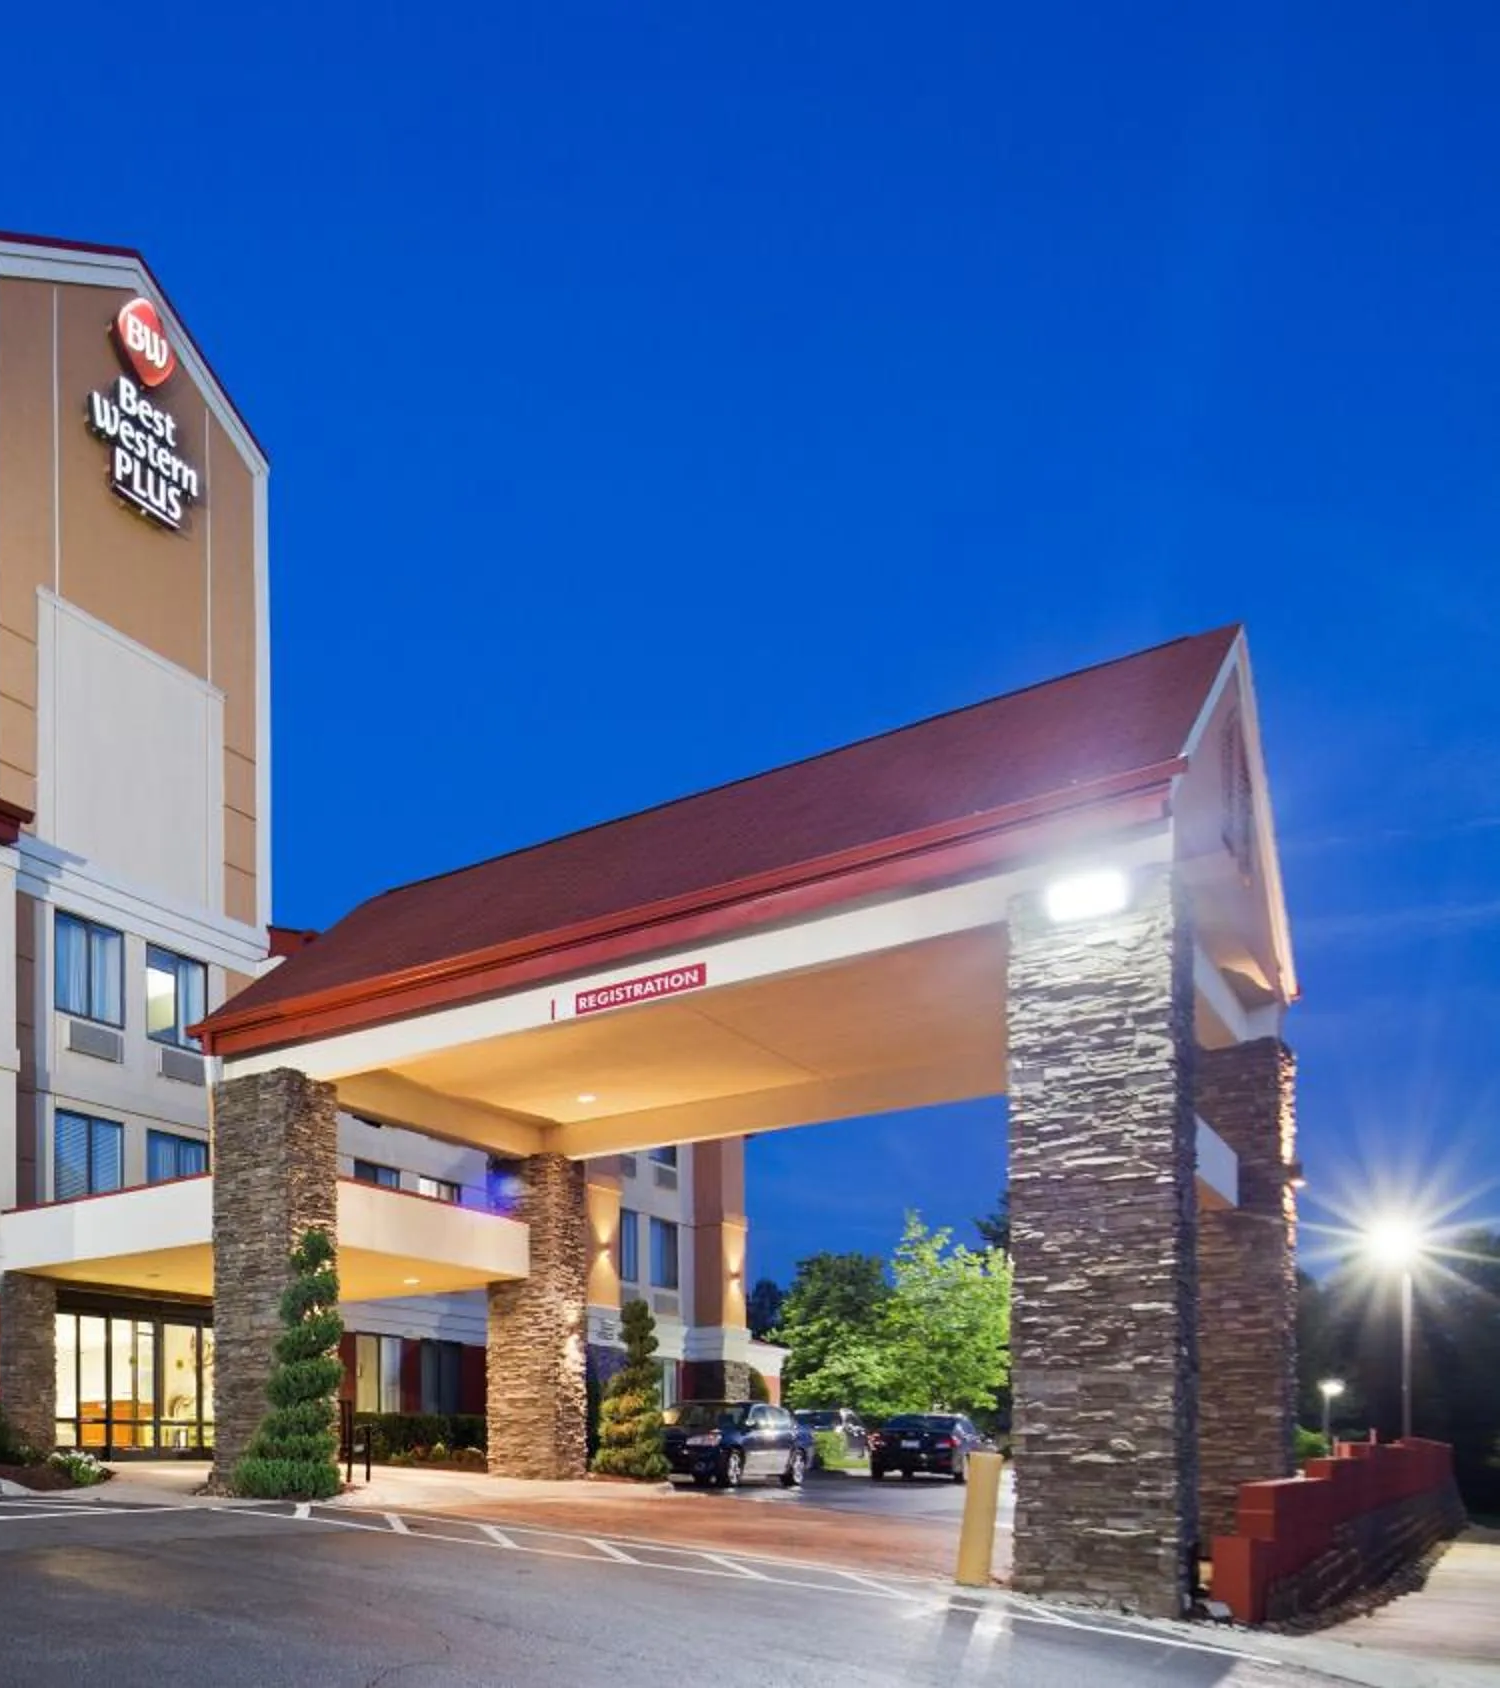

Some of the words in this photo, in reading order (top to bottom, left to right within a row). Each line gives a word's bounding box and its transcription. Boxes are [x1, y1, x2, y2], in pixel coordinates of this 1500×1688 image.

[126, 311, 168, 369] BW
[92, 391, 198, 497] Western
[119, 375, 176, 447] Best
[115, 447, 183, 521] PLUS
[578, 969, 700, 1011] REGISTRATION
